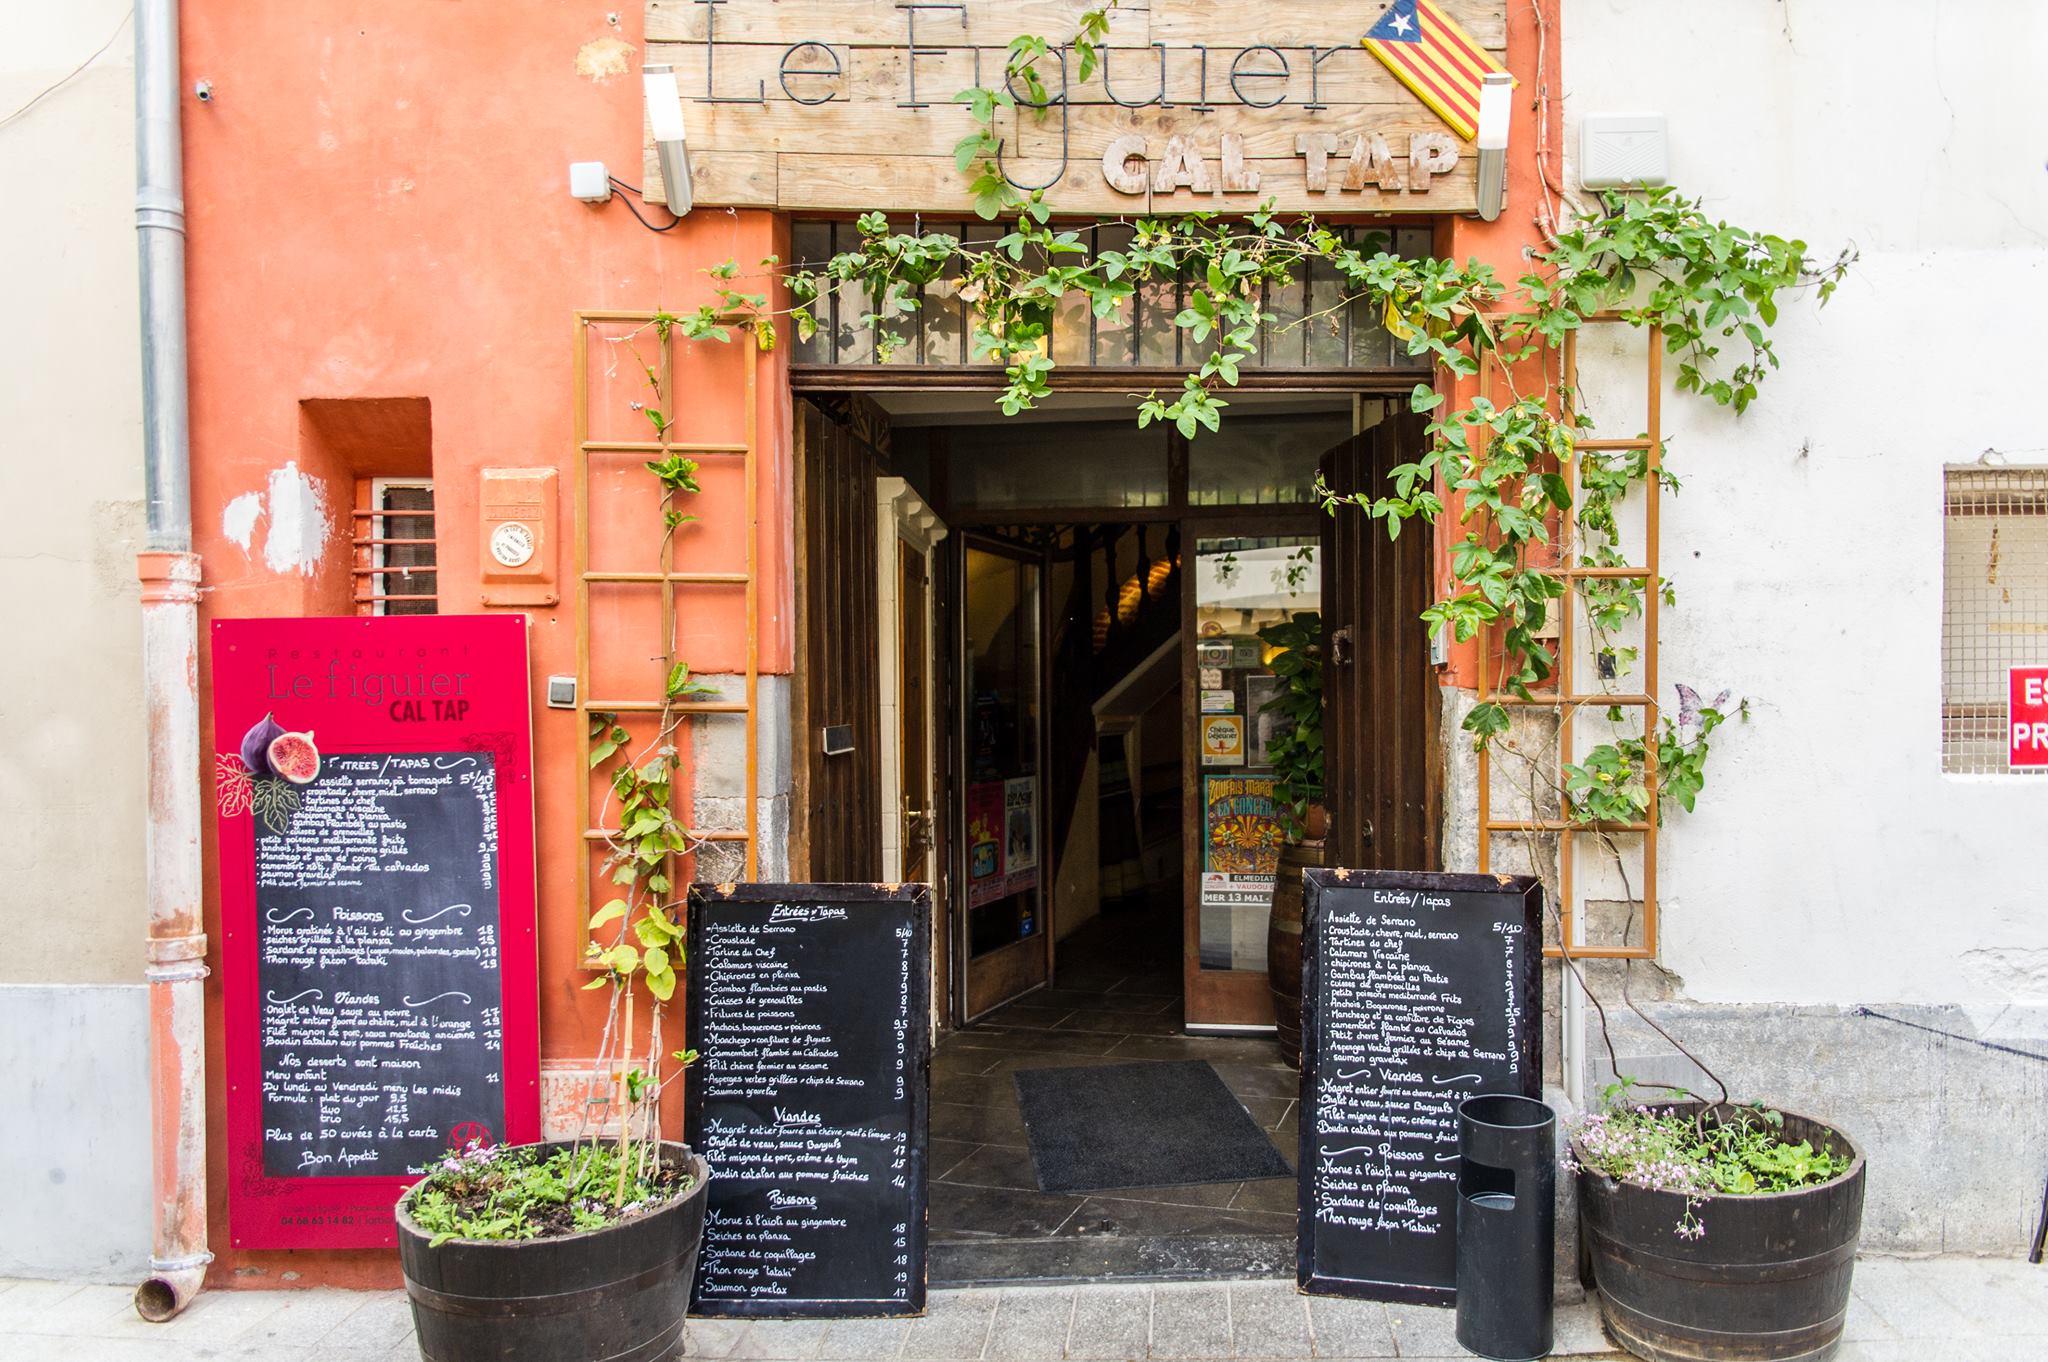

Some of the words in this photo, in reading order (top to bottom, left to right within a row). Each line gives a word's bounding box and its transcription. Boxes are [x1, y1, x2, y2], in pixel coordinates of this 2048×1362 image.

[693, 0, 842, 106] Le
[1102, 133, 1261, 195] CAL
[1295, 132, 1459, 192] TAP
[267, 664, 313, 698] Le
[326, 659, 470, 706] figuier
[390, 700, 426, 722] CAL
[432, 700, 470, 722] TAP
[1208, 731, 1238, 741] Déjeuner
[1210, 726, 1235, 735] Chèque
[1204, 894, 1225, 902] MER
[1228, 893, 1242, 903] 13
[1244, 894, 1263, 902] MAI
[333, 907, 384, 922] Poissons
[1328, 910, 1361, 924] Assiette
[1366, 915, 1377, 925] de
[1381, 915, 1415, 927] Serrano
[1492, 922, 1522, 934] 5/10
[711, 922, 747, 934] Assiette
[763, 925, 796, 933] Serrano
[711, 935, 755, 945] Croustade
[902, 939, 908, 948] 7
[1428, 931, 1459, 940] serrano
[1504, 935, 1514, 945] 7
[708, 945, 739, 956] Tartine
[742, 948, 752, 956] du
[901, 949, 908, 958] 7
[1328, 937, 1366, 948] Tartines
[1370, 940, 1380, 948] du
[1384, 940, 1403, 952] chef
[1505, 946, 1514, 957] 7
[266, 955, 288, 964] Thon
[291, 958, 315, 969] rouge
[480, 959, 497, 968] 19
[1329, 948, 1368, 958] Calamars
[1506, 960, 1513, 968] 8
[1331, 959, 1371, 970] chipirones
[1387, 962, 1398, 970] la
[1401, 963, 1433, 973] planxa
[1506, 971, 1514, 980] 7
[1330, 969, 1365, 980] Gambas
[1367, 970, 1405, 983] flambées
[1423, 973, 1449, 984] Pastis
[1505, 980, 1514, 992] 9
[335, 991, 379, 1004] Viandes
[710, 1008, 743, 1019] Fritures
[745, 1010, 755, 1018] de
[758, 1011, 795, 1020] poissons
[900, 1006, 907, 1016] 7
[279, 1054, 301, 1067] Nos
[307, 1057, 346, 1067] desserts
[355, 1058, 377, 1067] sont
[382, 1059, 421, 1069] maison
[1334, 1054, 1365, 1063] saumon
[1369, 1055, 1408, 1065] gravelax
[266, 1070, 290, 1079] Menu
[295, 1071, 327, 1080] enfant
[486, 1073, 499, 1082] 11
[1379, 1068, 1423, 1082] Viandes
[263, 1083, 278, 1091] Du
[284, 1082, 310, 1091] lundi
[333, 1081, 378, 1091] Vendredi
[383, 1085, 408, 1093] menu
[413, 1085, 427, 1094] les
[433, 1085, 461, 1096] midis
[320, 1093, 340, 1106] plat
[357, 1094, 379, 1108] jour
[390, 1093, 407, 1103] 9,5
[321, 1106, 340, 1115] duo
[386, 1105, 407, 1114] 12,5
[773, 1106, 821, 1123] Viandes
[320, 1115, 341, 1124] trio
[384, 1114, 409, 1124] 15,5
[266, 1129, 292, 1141] Plus
[300, 1131, 313, 1140] de
[320, 1129, 336, 1138] 50
[341, 1126, 372, 1138] cuvées
[379, 1128, 388, 1138] à
[392, 1128, 403, 1138] la
[409, 1128, 438, 1138] carte
[708, 1135, 737, 1148] Onglet
[807, 1139, 841, 1151] Banyuls
[893, 1145, 906, 1155] 17
[1378, 1143, 1424, 1160] Poissons
[298, 1151, 332, 1169] Bon
[338, 1147, 378, 1167] Appetit
[1321, 1177, 1358, 1190] Seiches
[1376, 1180, 1410, 1194] planxa
[767, 1189, 816, 1205] Poissons
[1322, 1192, 1364, 1207] Sardane
[1368, 1199, 1379, 1208] de
[1384, 1200, 1437, 1217] coquillages
[1318, 1207, 1345, 1224] Thon
[1348, 1215, 1372, 1230] rouge
[707, 1228, 742, 1240] Seiches
[759, 1230, 791, 1242] planxa
[894, 1238, 906, 1246] 15
[706, 1245, 745, 1258] Sardane
[749, 1249, 761, 1258] de
[764, 1249, 816, 1262] coquillages
[893, 1256, 907, 1264] 18
[703, 1260, 729, 1274] Thon
[733, 1268, 759, 1277] rouge
[894, 1272, 907, 1281] 19
[705, 1277, 747, 1292] Saumon
[750, 1284, 787, 1295] gravelax
[893, 1288, 906, 1297] 17
